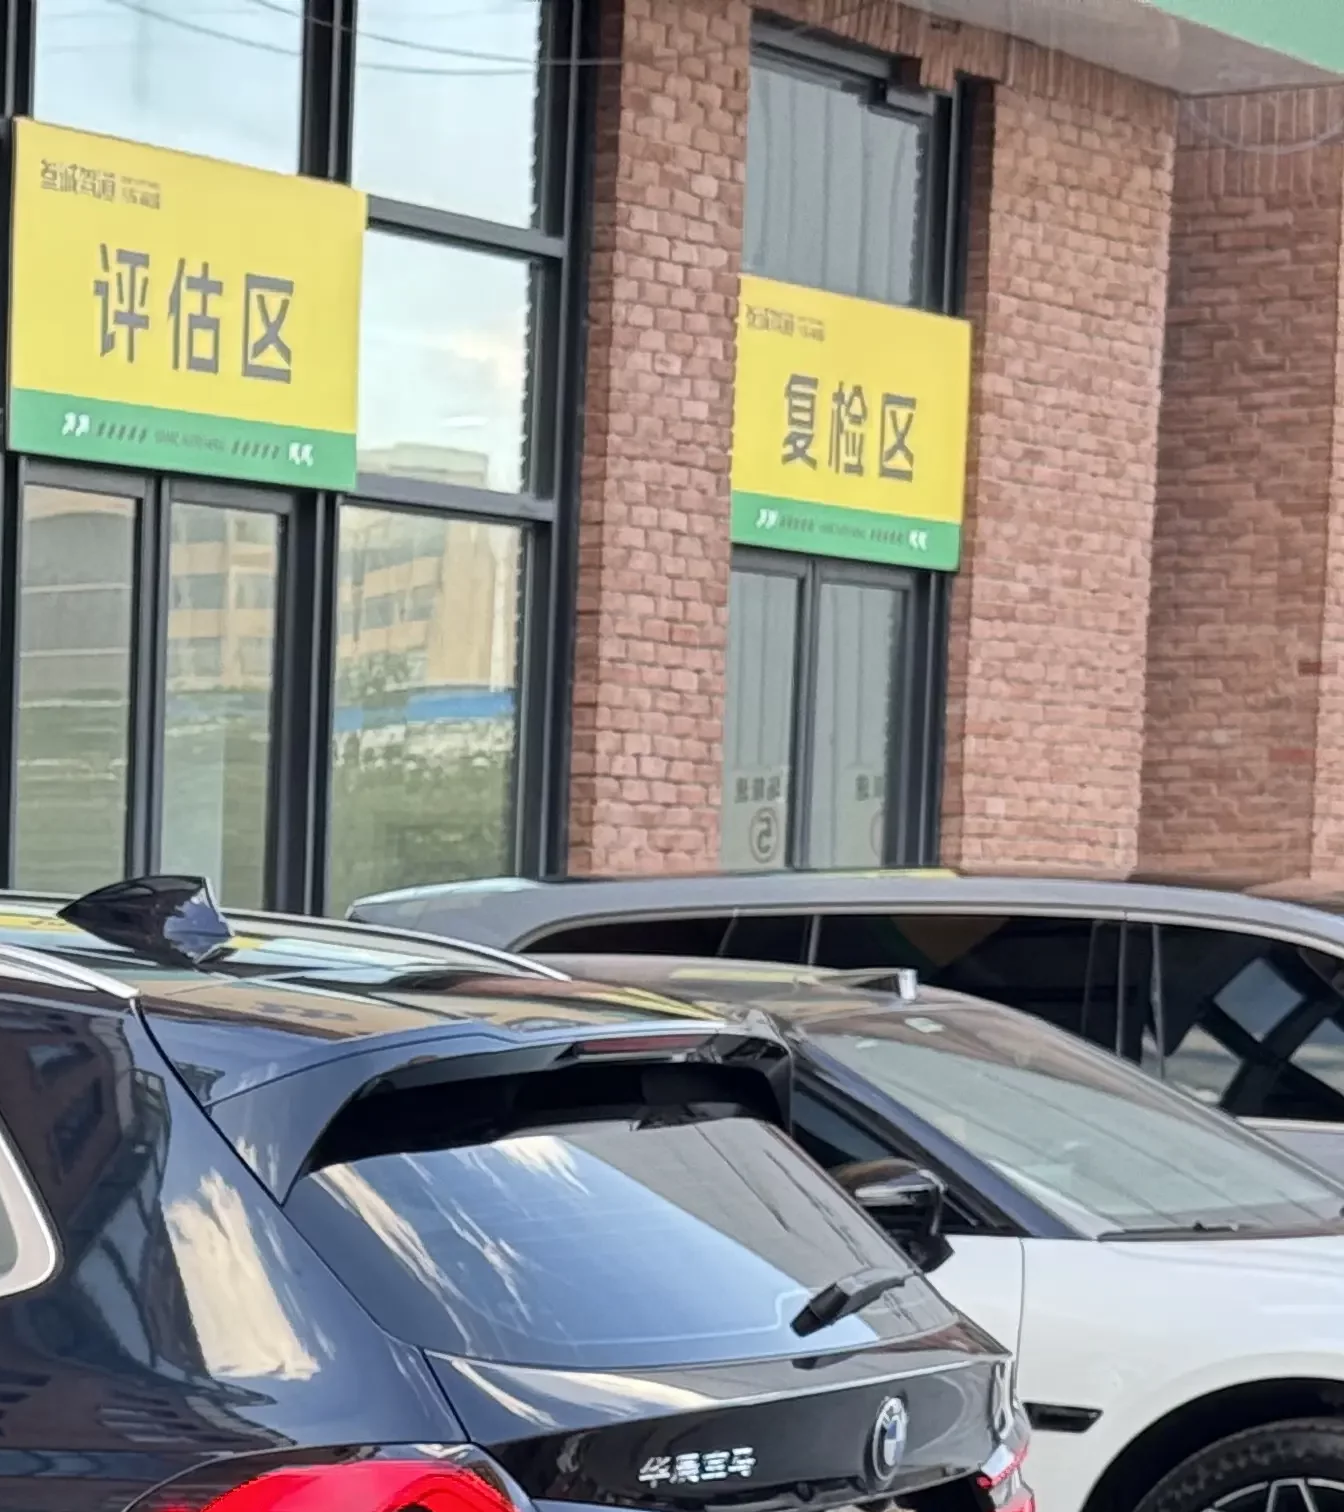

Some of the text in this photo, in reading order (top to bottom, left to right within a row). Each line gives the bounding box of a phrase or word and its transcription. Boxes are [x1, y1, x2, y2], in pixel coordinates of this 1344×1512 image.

[93, 243, 294, 384] 评估区
[781, 374, 917, 482] 复检区
[639, 1447, 756, 1488] 华晨宝马
